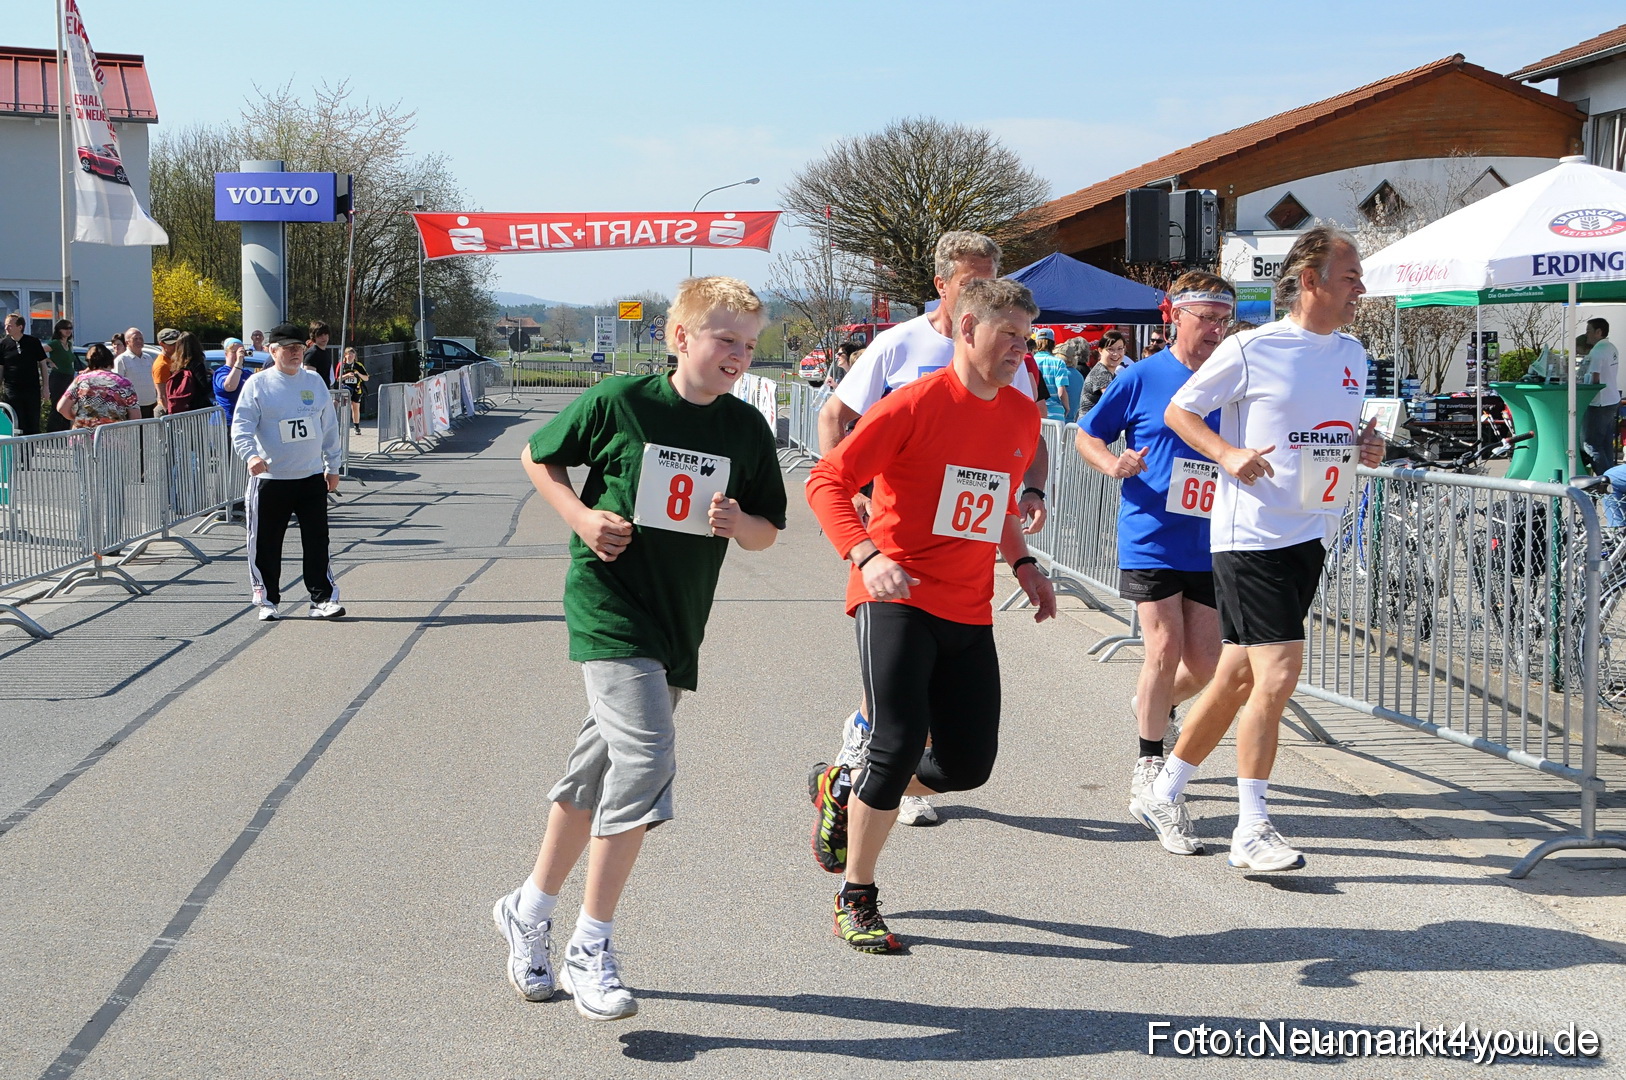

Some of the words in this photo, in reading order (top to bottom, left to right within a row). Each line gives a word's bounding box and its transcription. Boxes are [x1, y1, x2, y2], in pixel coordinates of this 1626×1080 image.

[226, 187, 319, 205] VOLVO
[1553, 209, 1625, 225] ERDINGER
[1531, 251, 1625, 277] ERDING
[287, 420, 308, 439] 75
[659, 449, 699, 465] MEYER
[1312, 448, 1341, 457] MEYER
[658, 459, 698, 473] WERBUNG
[1182, 468, 1210, 477] WERBUNG
[1183, 461, 1211, 472] MEYER
[956, 478, 987, 488] WERBUNG
[957, 469, 988, 481] MEYER
[1322, 465, 1339, 502] 2
[666, 473, 694, 521] 8
[1181, 477, 1216, 513] 66
[951, 490, 995, 534] 62
